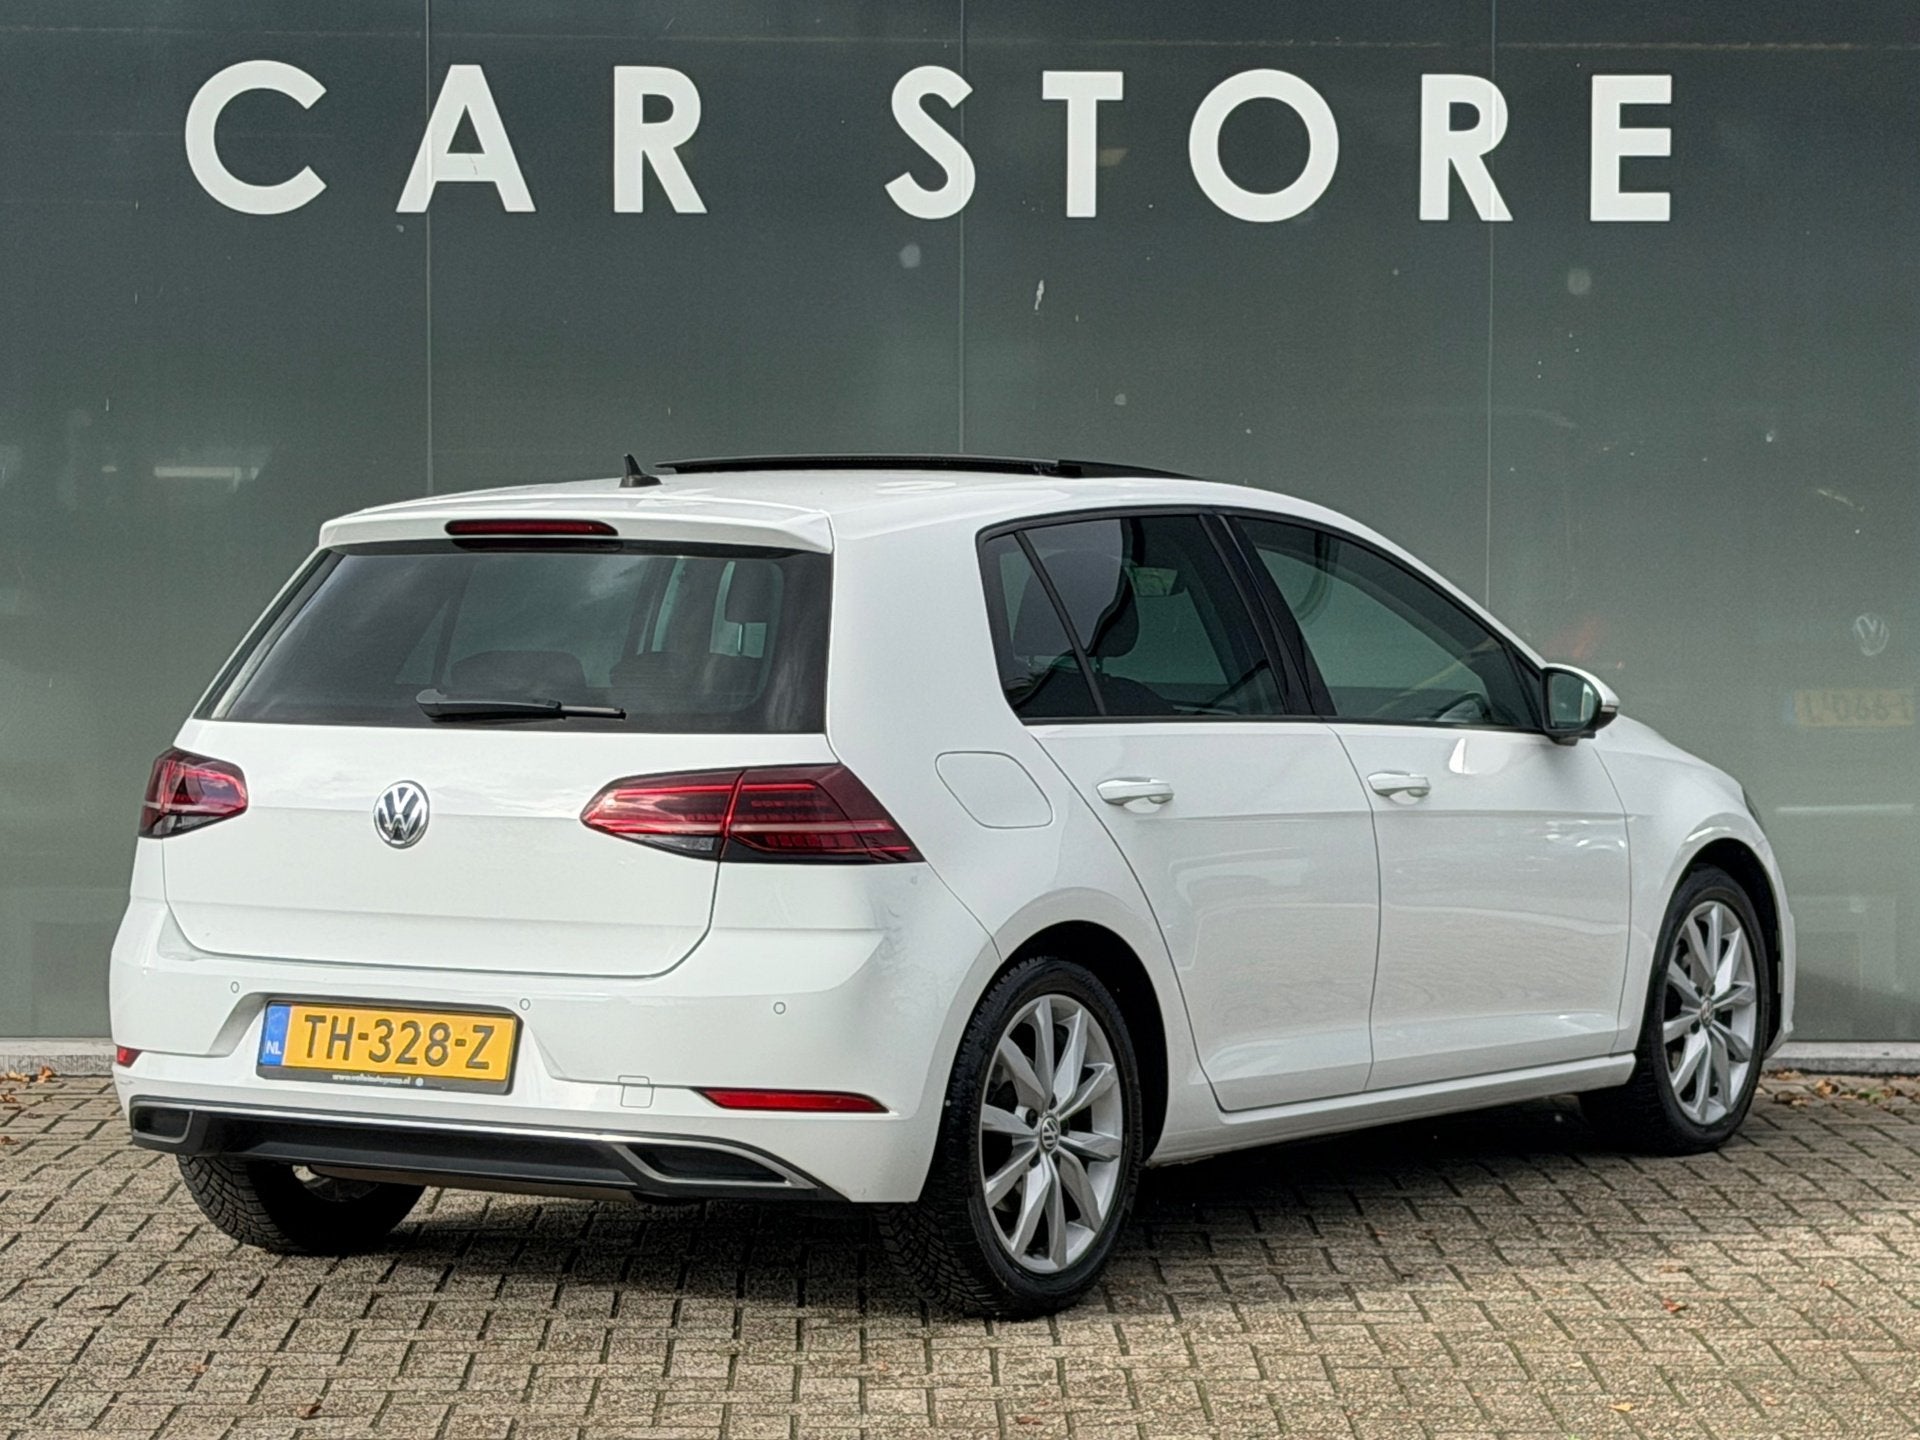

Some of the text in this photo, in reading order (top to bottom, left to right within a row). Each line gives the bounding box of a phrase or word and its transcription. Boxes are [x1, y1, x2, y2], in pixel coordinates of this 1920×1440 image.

[186, 61, 1672, 223] CAR STORE
[374, 781, 429, 848] VW
[265, 1015, 495, 1070] NL TH-328-Z
